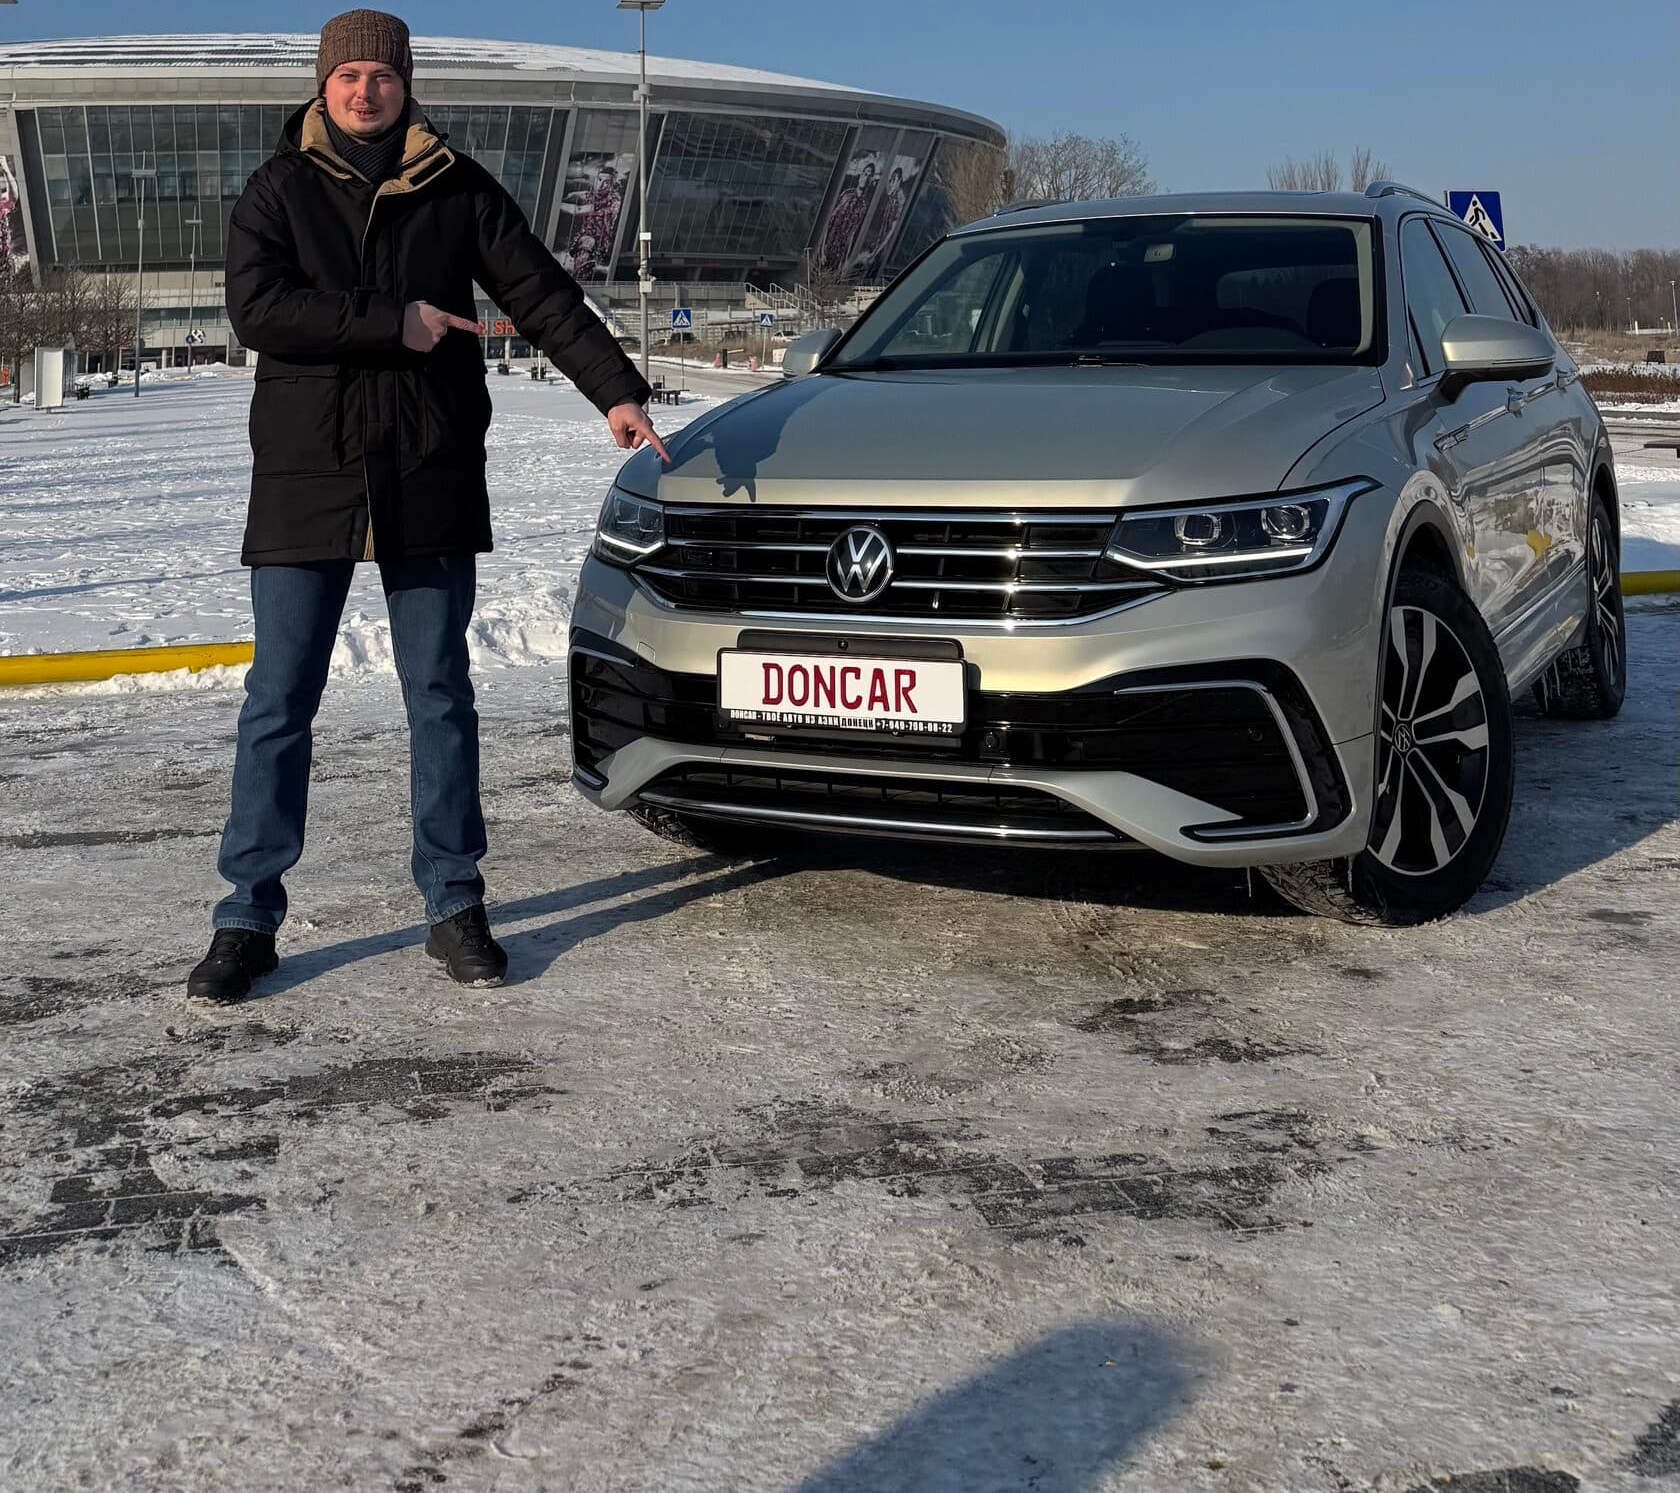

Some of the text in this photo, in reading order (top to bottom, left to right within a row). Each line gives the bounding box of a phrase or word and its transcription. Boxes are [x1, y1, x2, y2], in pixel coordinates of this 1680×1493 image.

[828, 528, 892, 600] VW
[761, 662, 918, 714] DONCAR
[783, 713, 803, 723] АВТО
[805, 714, 816, 725] ИЗ
[818, 715, 839, 726] АЗИИ
[841, 717, 874, 728] ДОНЕЦК
